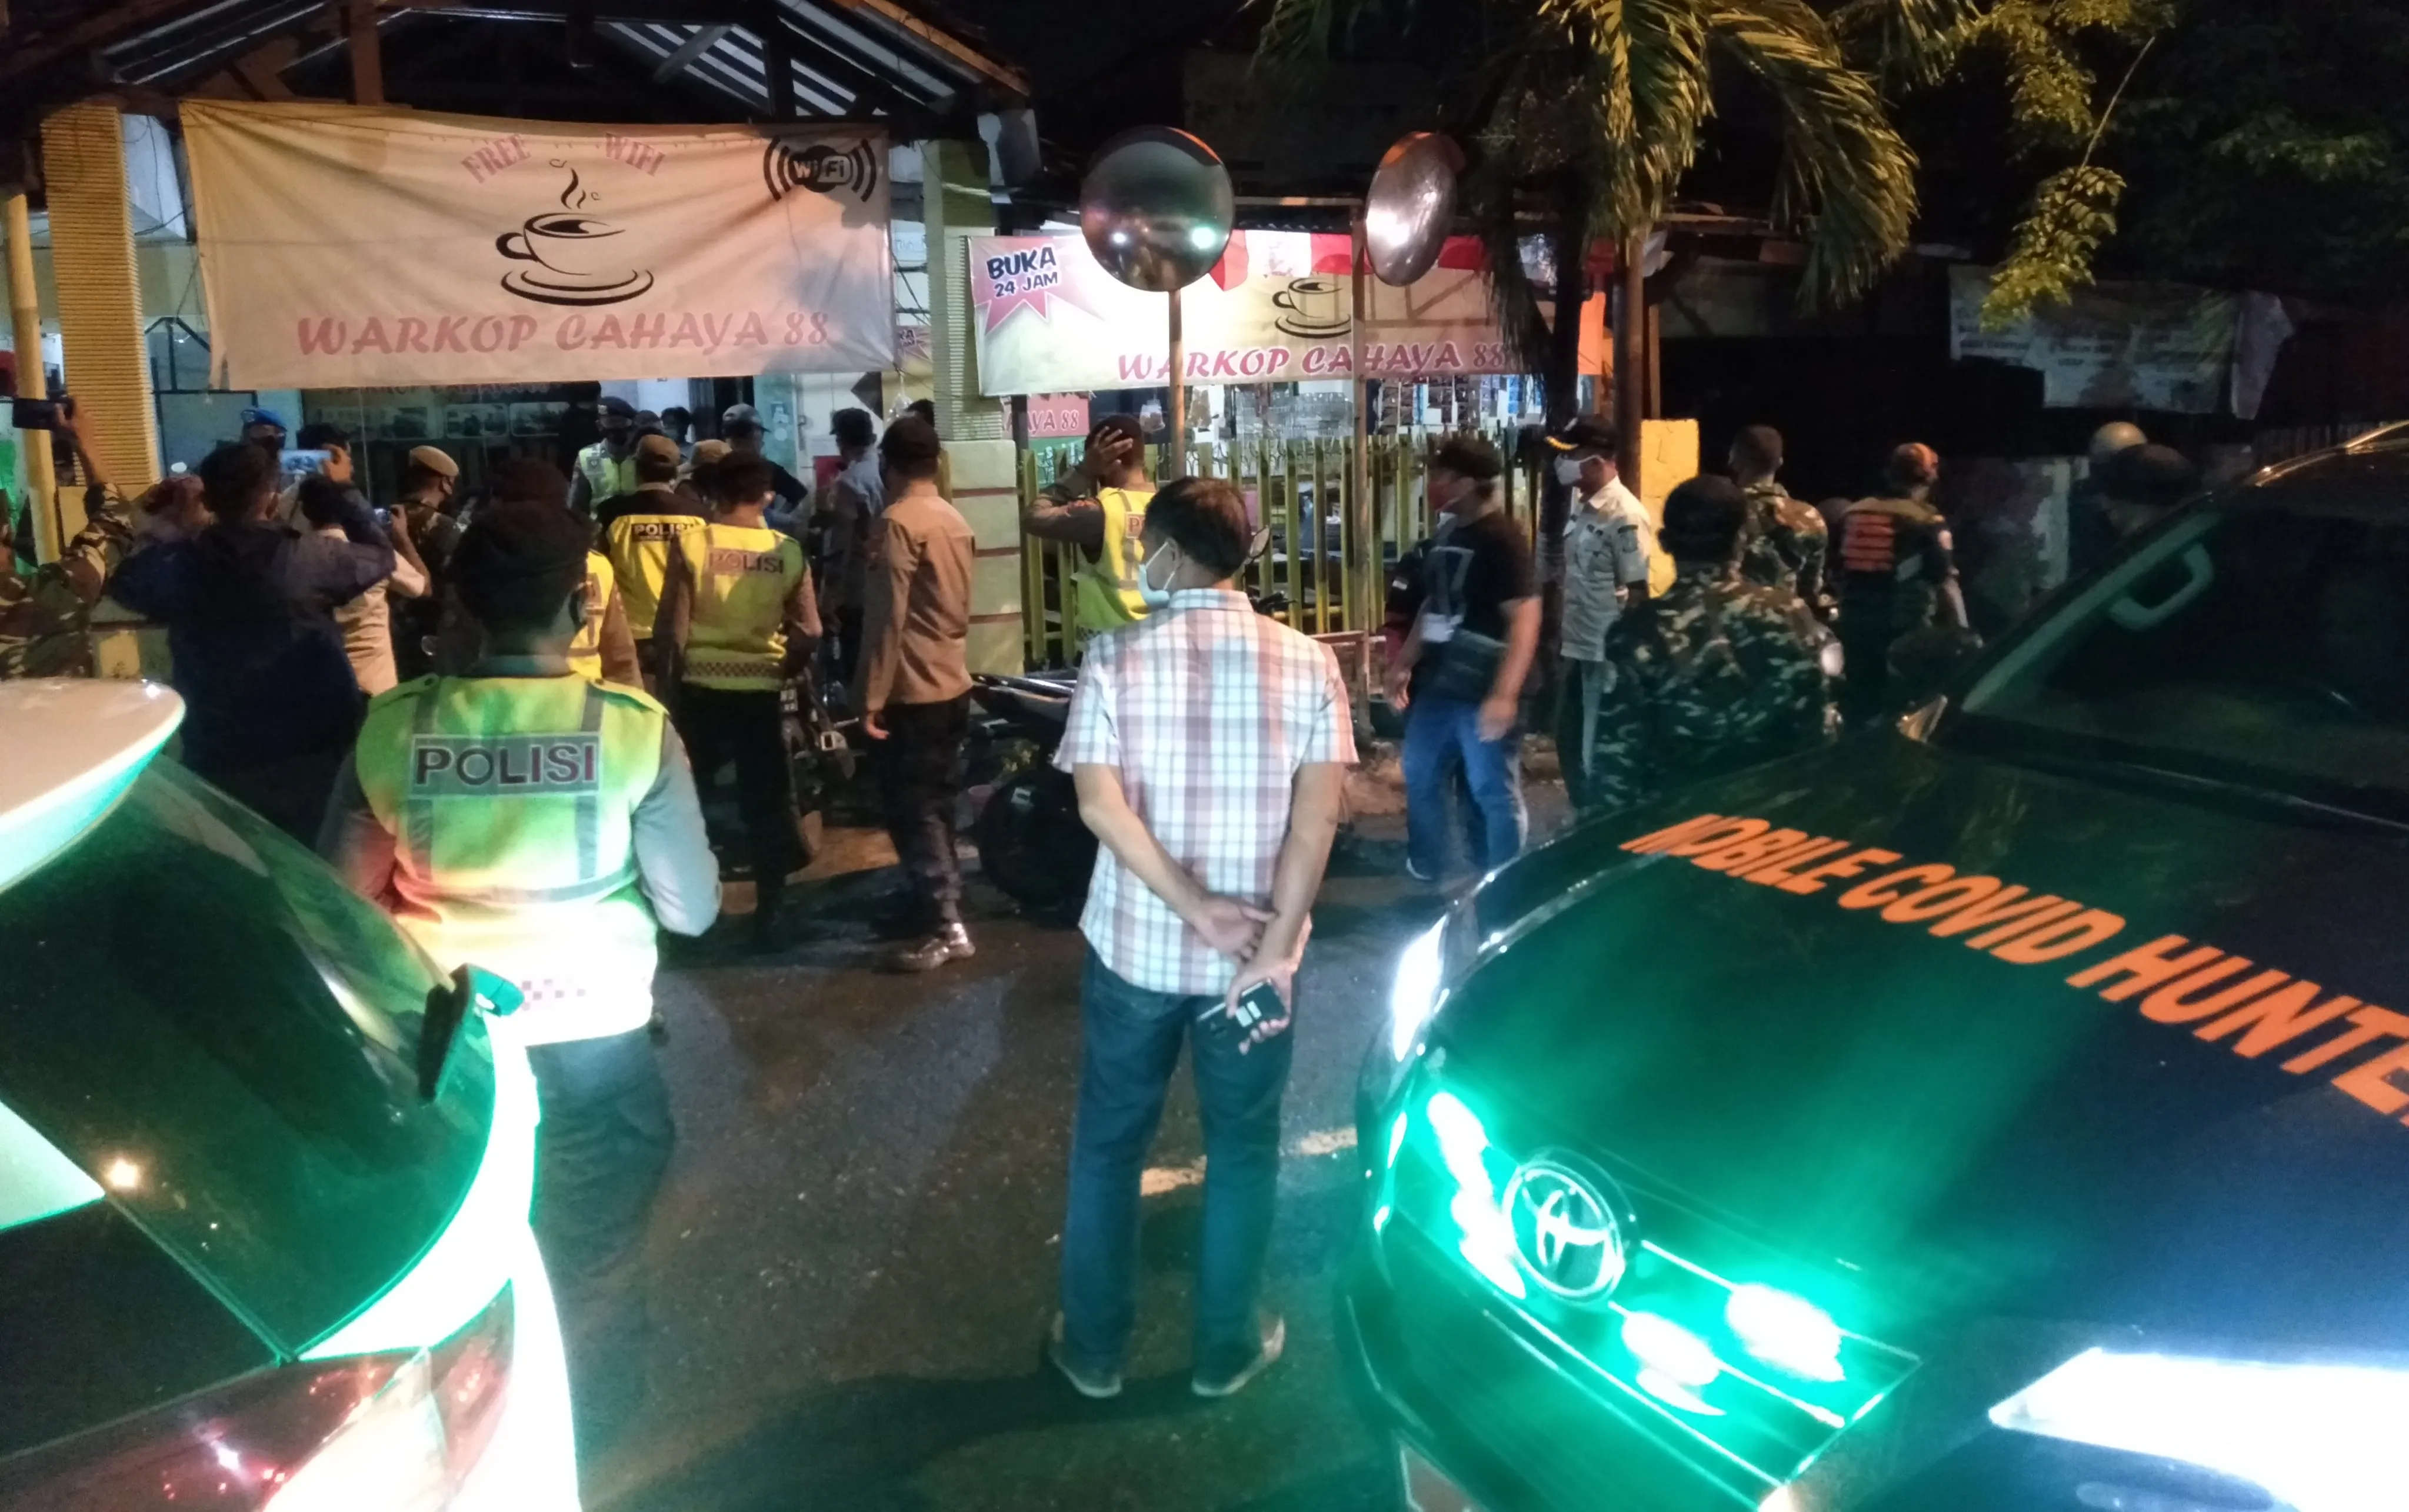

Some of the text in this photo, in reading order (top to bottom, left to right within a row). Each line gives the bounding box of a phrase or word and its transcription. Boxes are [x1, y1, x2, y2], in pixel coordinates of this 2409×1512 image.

[461, 132, 666, 183] FREE WIFI
[985, 247, 1057, 281] BUKA
[994, 272, 1058, 298] 24 JAM
[297, 312, 830, 355] WARKOP CAHAYA 88
[1302, 343, 1460, 380] CAHAYA
[1061, 410, 1079, 430] 88
[709, 551, 784, 575] POLISI
[416, 745, 597, 786] POLISI
[1838, 862, 2125, 964] COVID
[2065, 933, 2409, 1128] HUNTE
